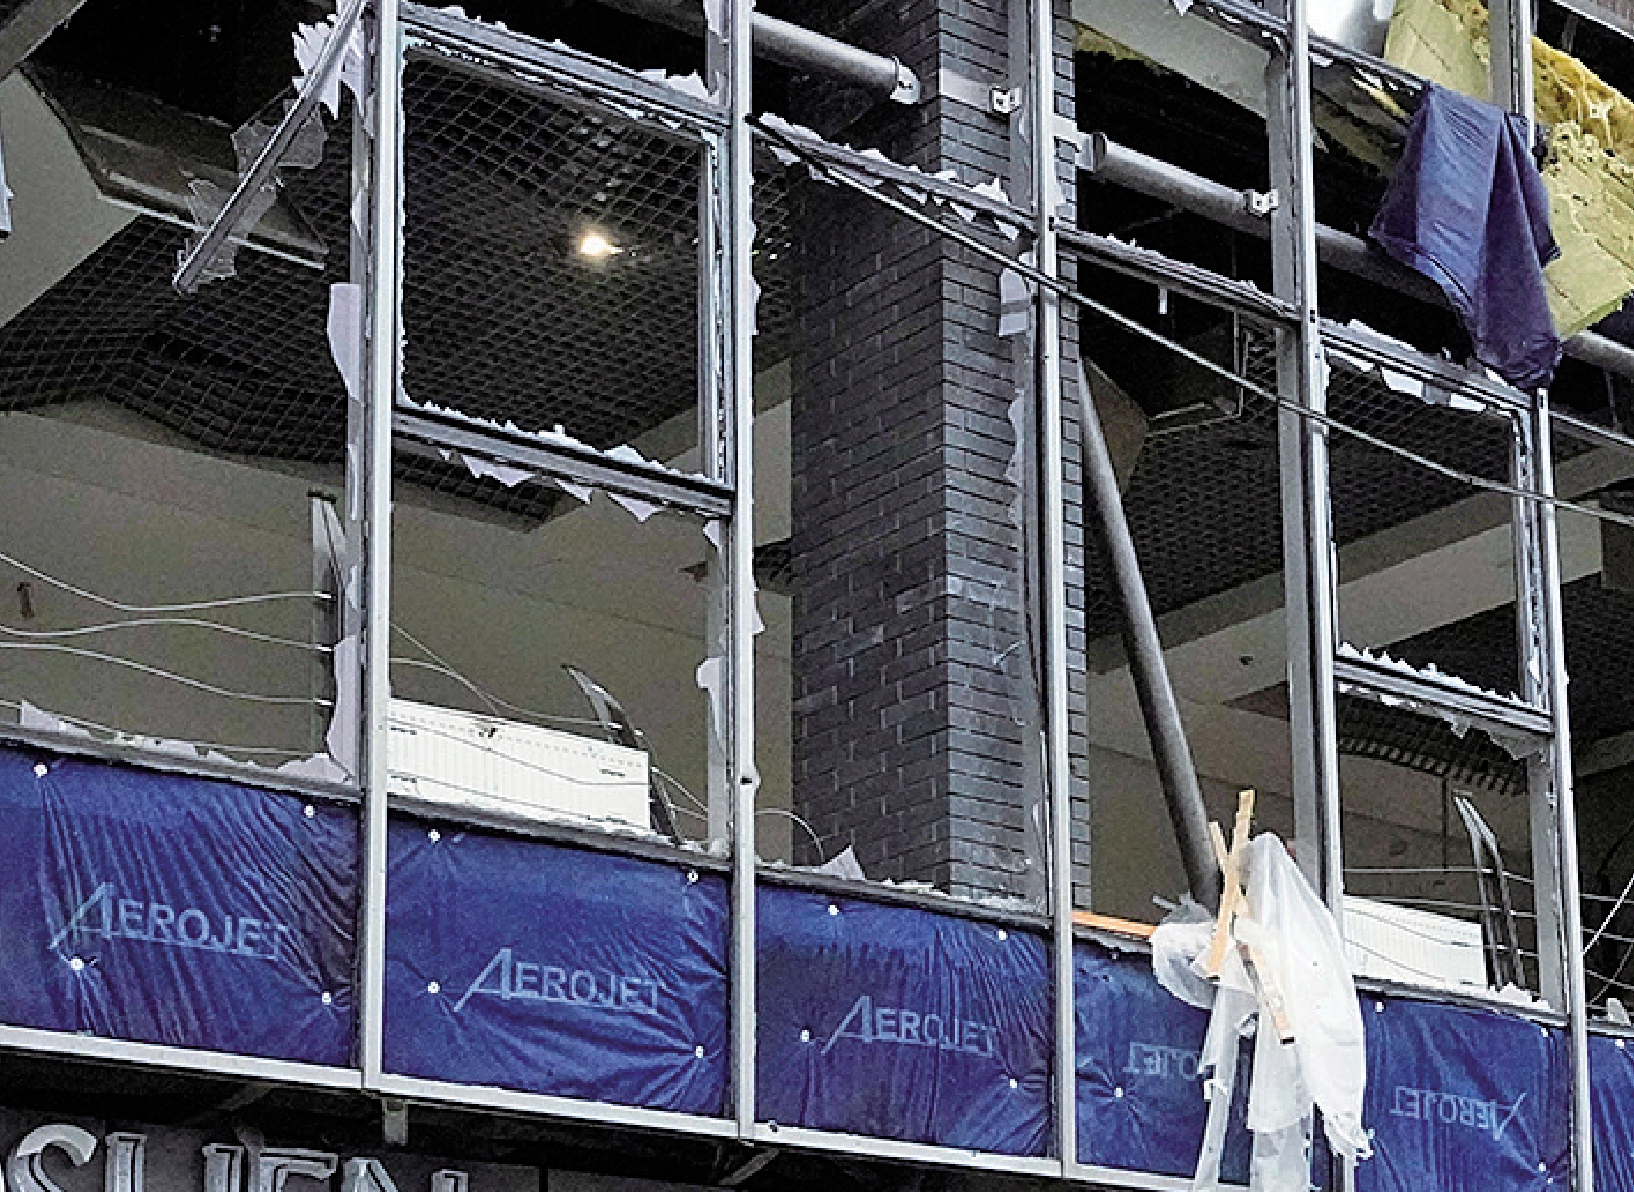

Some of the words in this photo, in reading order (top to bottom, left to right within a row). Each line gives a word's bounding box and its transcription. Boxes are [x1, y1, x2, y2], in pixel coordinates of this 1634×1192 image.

[49, 881, 289, 962] AEROJET
[454, 947, 660, 1014] AEROJET
[821, 994, 999, 1058] AEROJET
[1122, 1041, 1199, 1082] OJET
[1389, 1084, 1527, 1141] AEROJET
